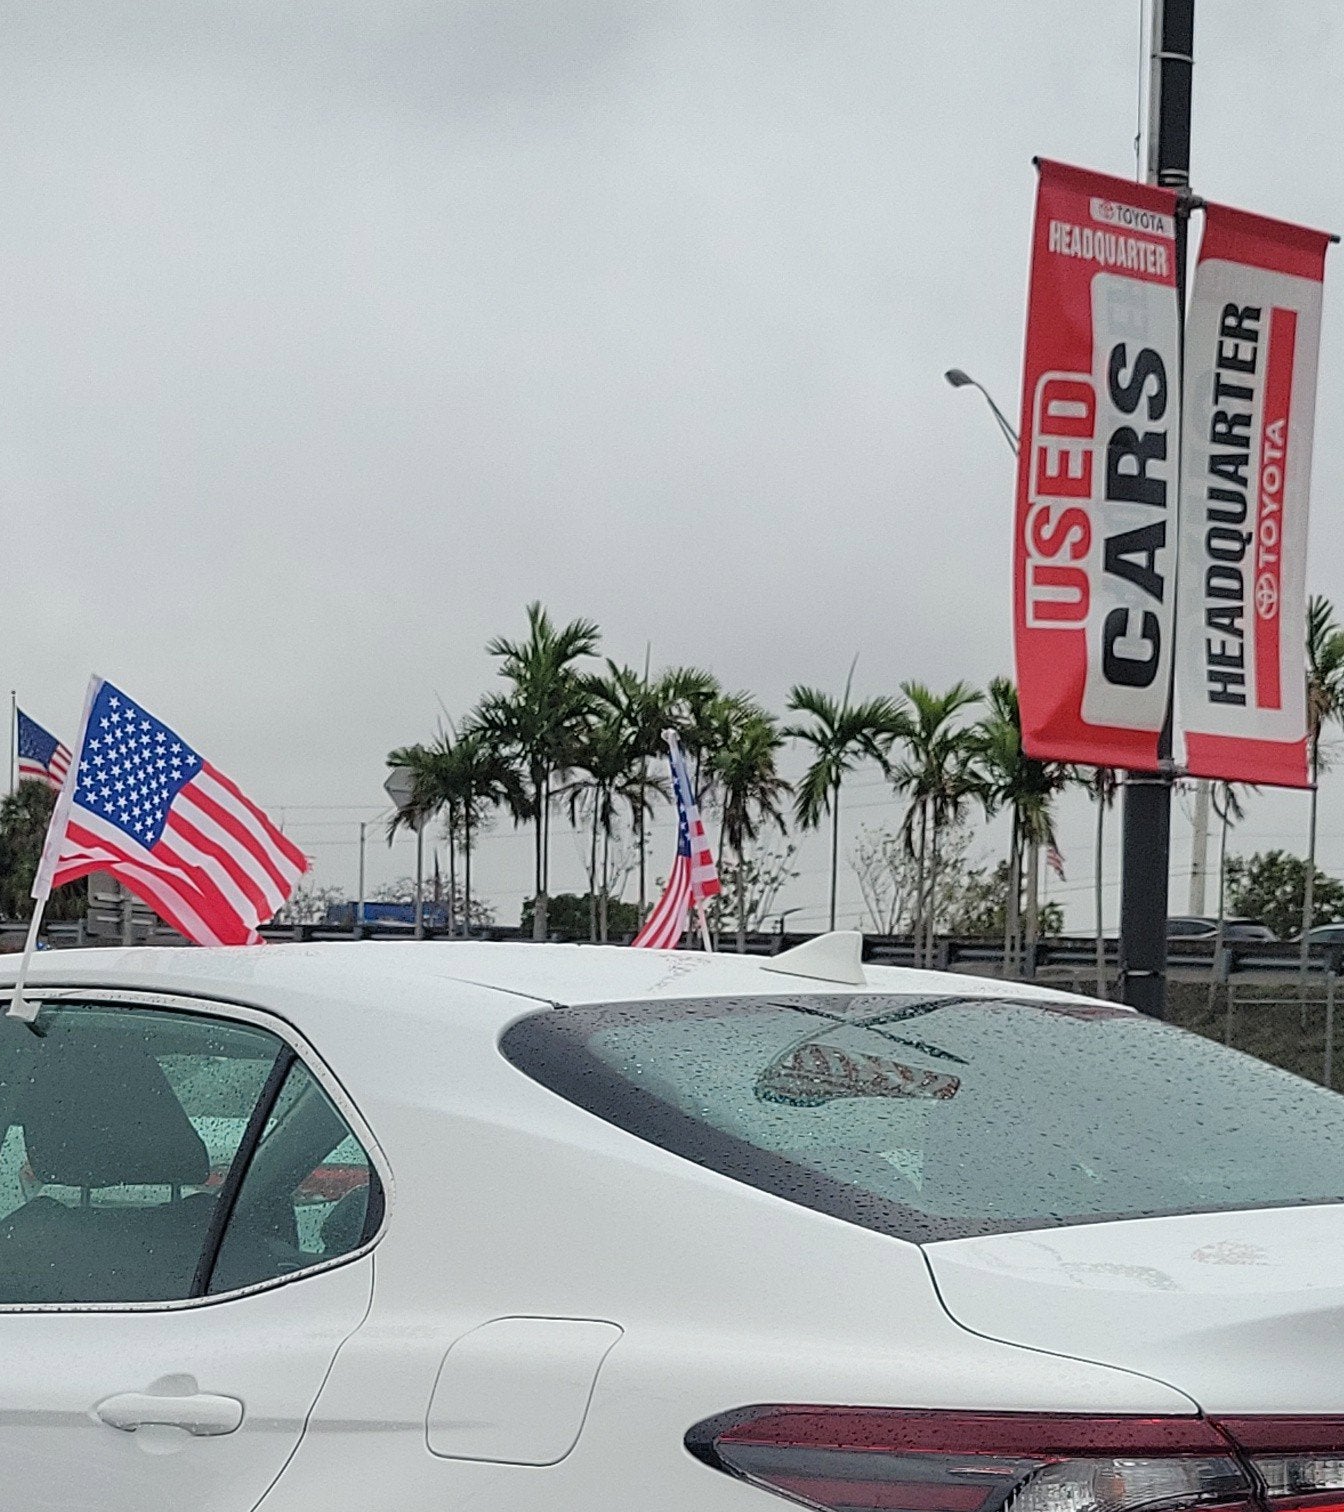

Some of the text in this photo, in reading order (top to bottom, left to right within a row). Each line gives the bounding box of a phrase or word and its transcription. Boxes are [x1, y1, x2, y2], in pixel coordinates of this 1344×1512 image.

[1049, 219, 1169, 278] HEADQUARTER
[1116, 207, 1165, 233] TOYOTA
[1026, 372, 1096, 628] USED
[1102, 342, 1167, 688] CARS
[1205, 302, 1262, 706] HEADQUARTER
[1258, 418, 1286, 569] TOYOTA
